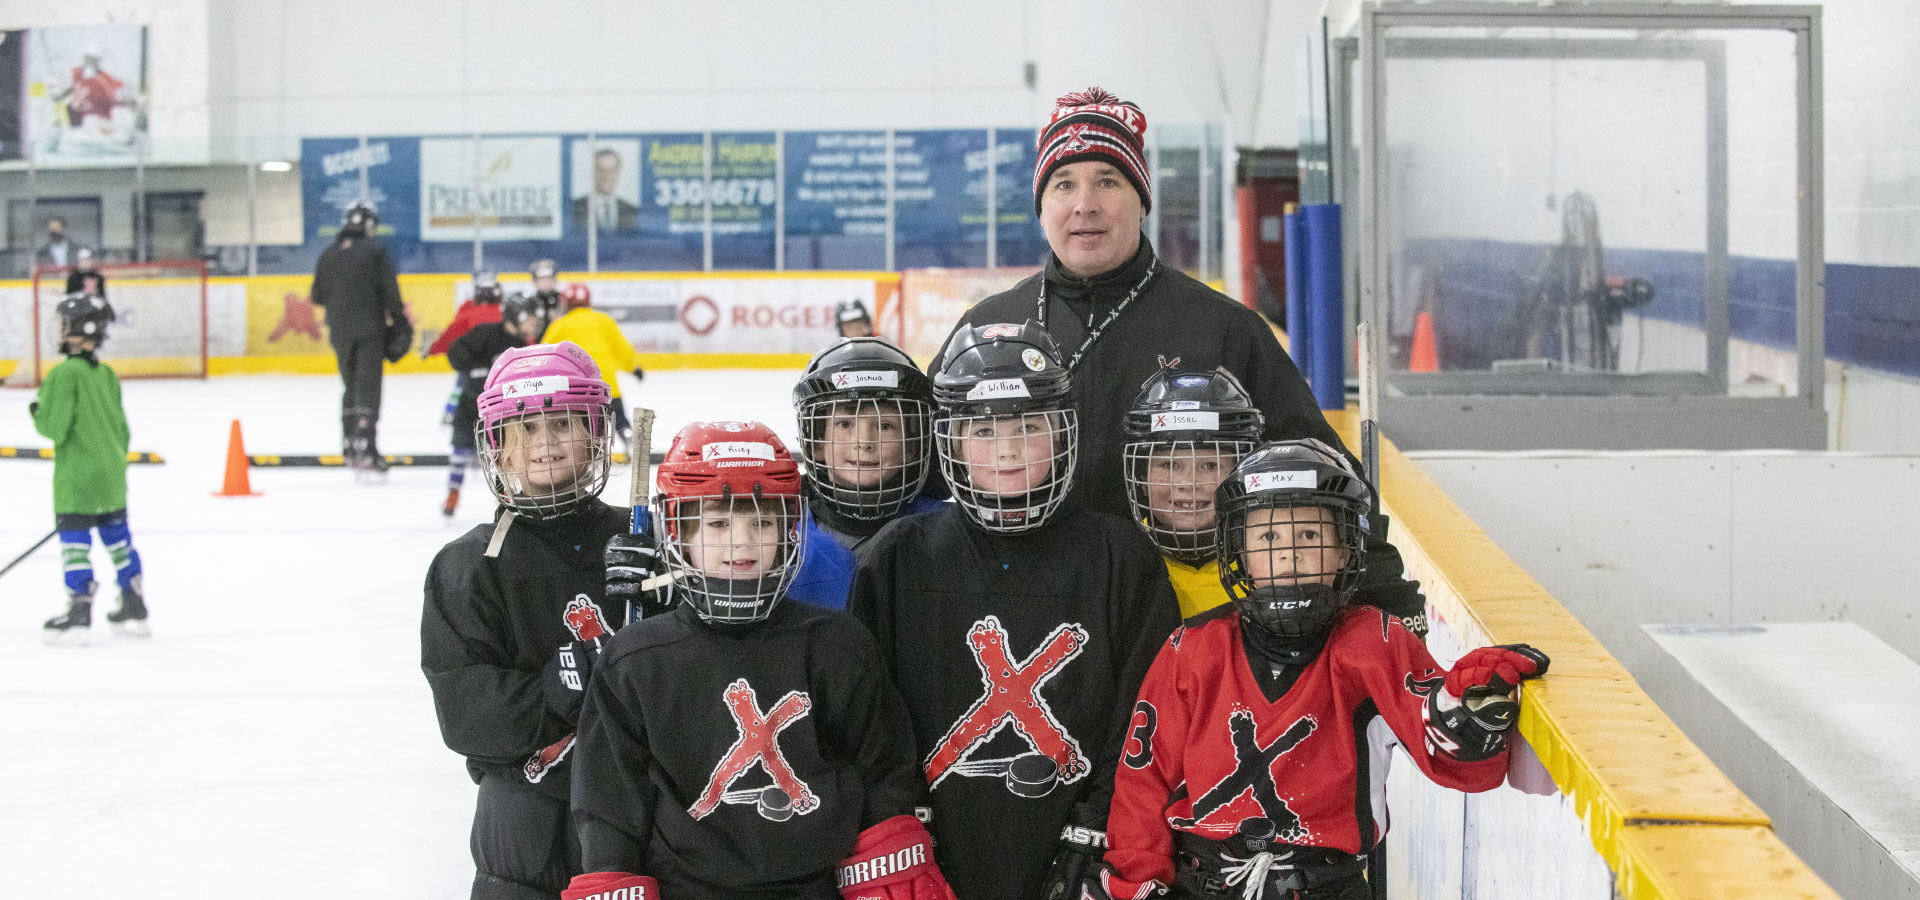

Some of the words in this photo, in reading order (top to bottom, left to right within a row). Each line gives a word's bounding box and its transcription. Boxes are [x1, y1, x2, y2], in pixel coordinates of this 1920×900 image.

[731, 303, 837, 329] ROGER
[717, 460, 765, 468] WARRIOR
[1272, 474, 1294, 483] MAX
[1269, 599, 1312, 610] CCM
